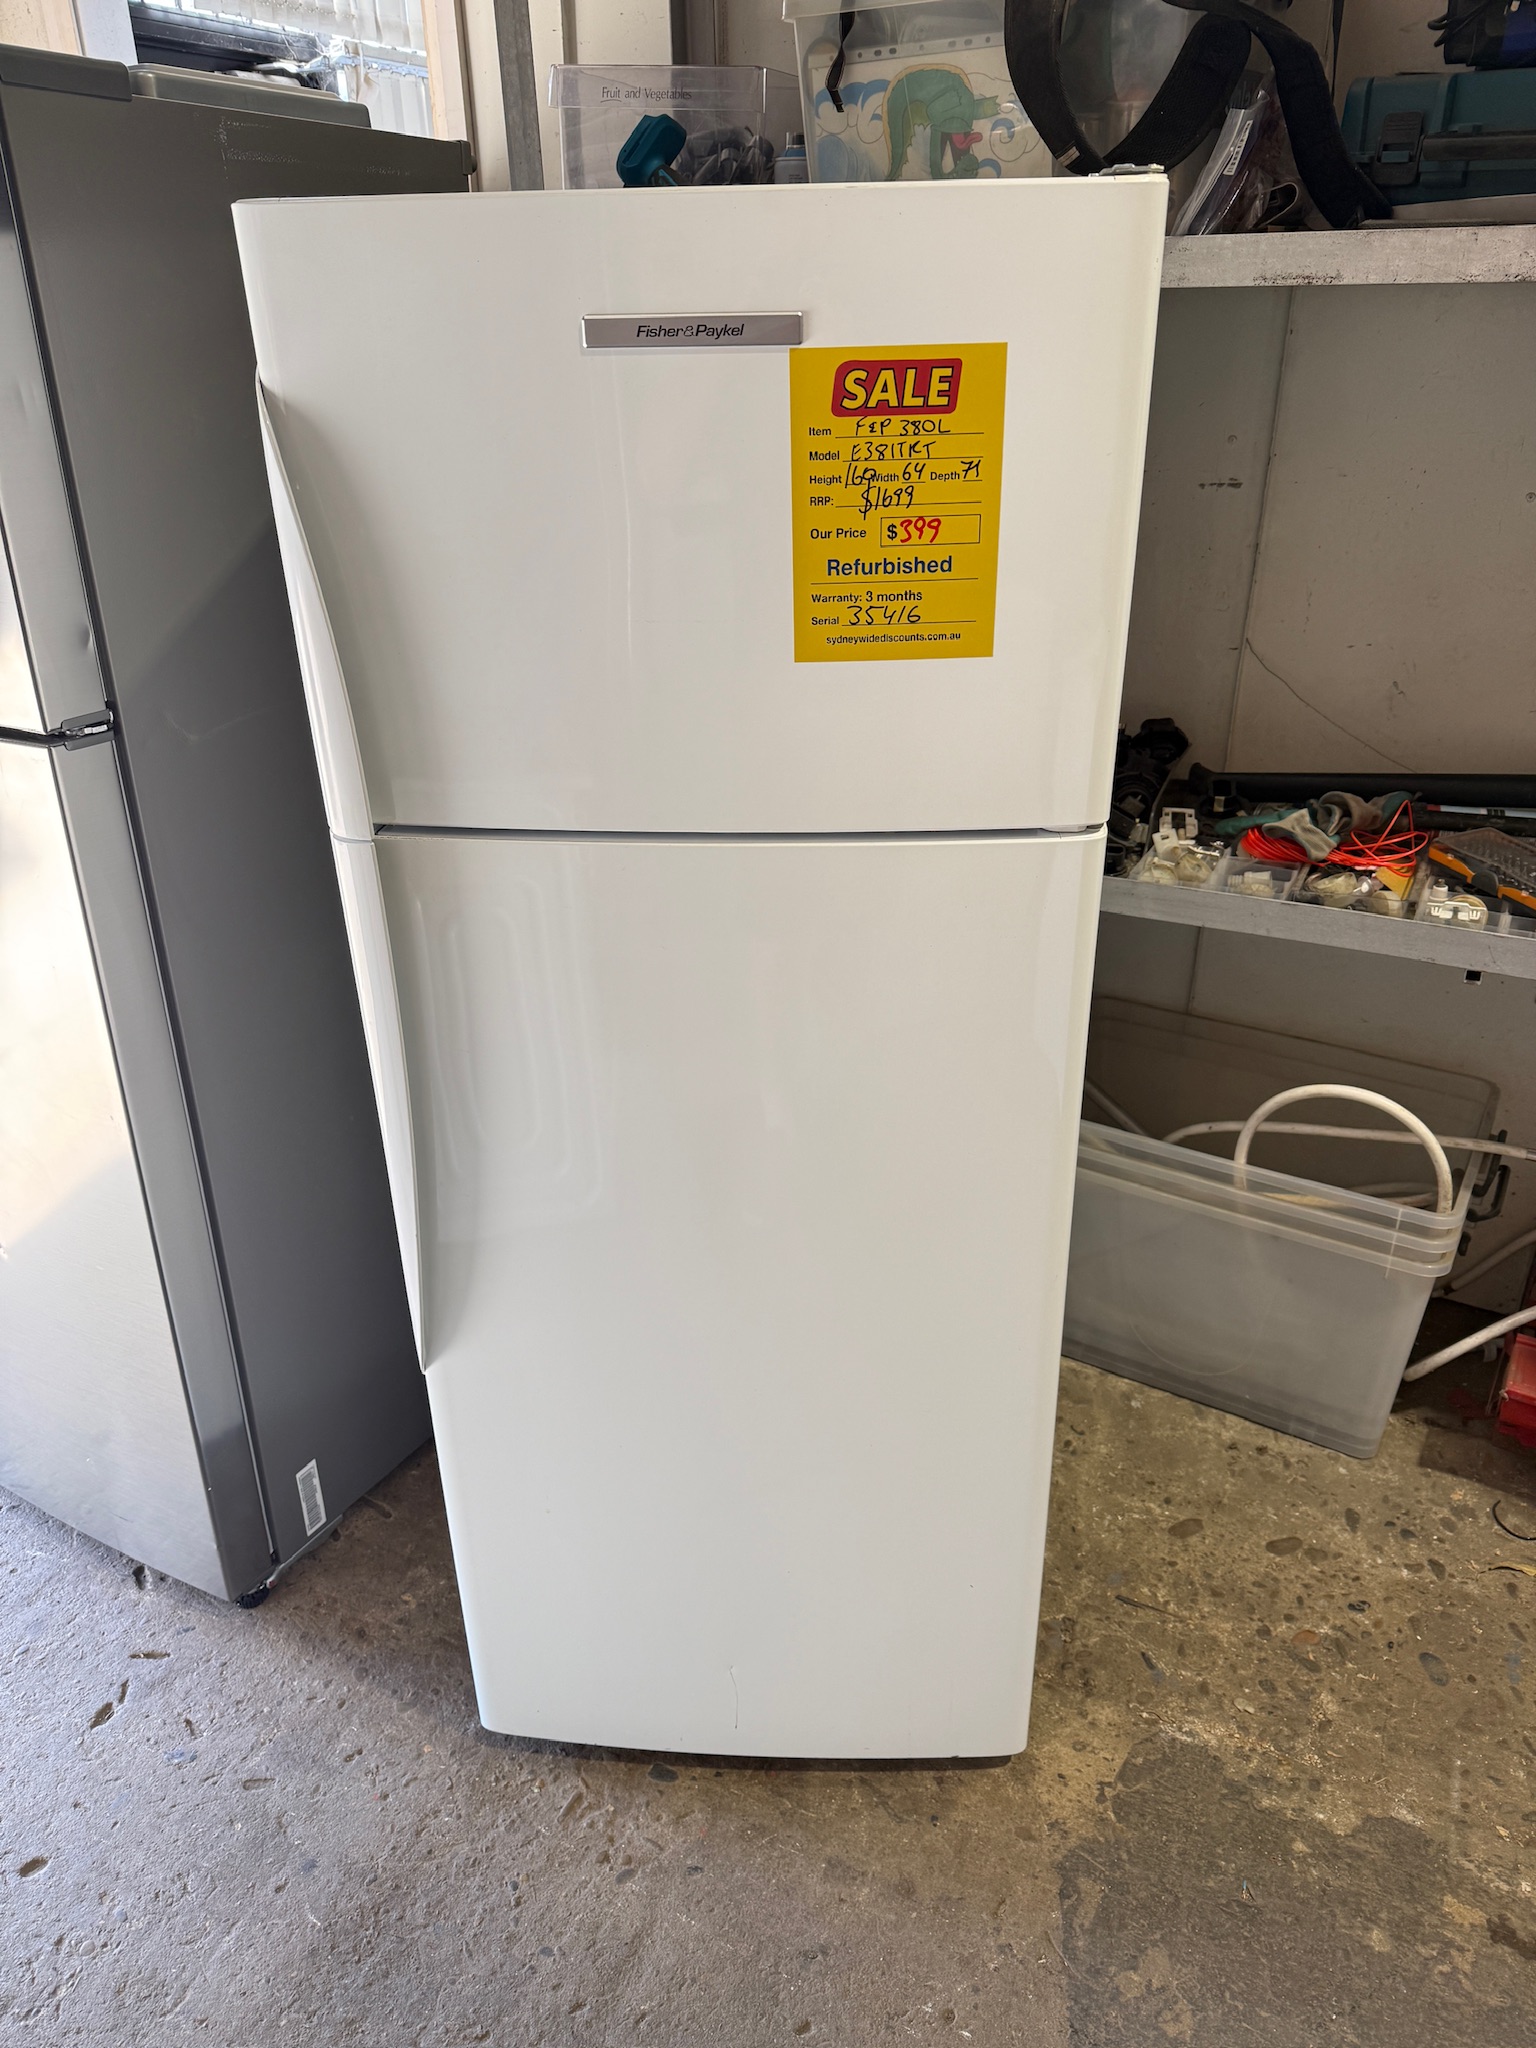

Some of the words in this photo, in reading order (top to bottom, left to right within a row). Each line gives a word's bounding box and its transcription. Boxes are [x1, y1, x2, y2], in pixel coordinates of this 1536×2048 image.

[601, 86, 622, 99] Fruit
[624, 86, 642, 99] and
[644, 87, 693, 101] Vegetables
[636, 324, 745, 340] Fisher&Paykel
[840, 366, 955, 411] SALE
[808, 426, 832, 437] Item
[899, 417, 951, 437] 380L
[809, 451, 840, 462] Model
[809, 474, 842, 486] Height
[871, 472, 900, 483] Width
[901, 462, 926, 481] 64
[930, 471, 960, 482] Depth
[809, 497, 834, 507] RRP:
[810, 529, 833, 540] Our
[836, 527, 867, 539] Price
[827, 556, 953, 577] Refurbished
[811, 594, 863, 604] Warranty:
[865, 592, 873, 602] 3
[876, 590, 923, 602] months
[811, 617, 840, 626] Serial
[847, 605, 922, 626] 35416
[826, 632, 961, 645] sydneywidediscounts.com.au
